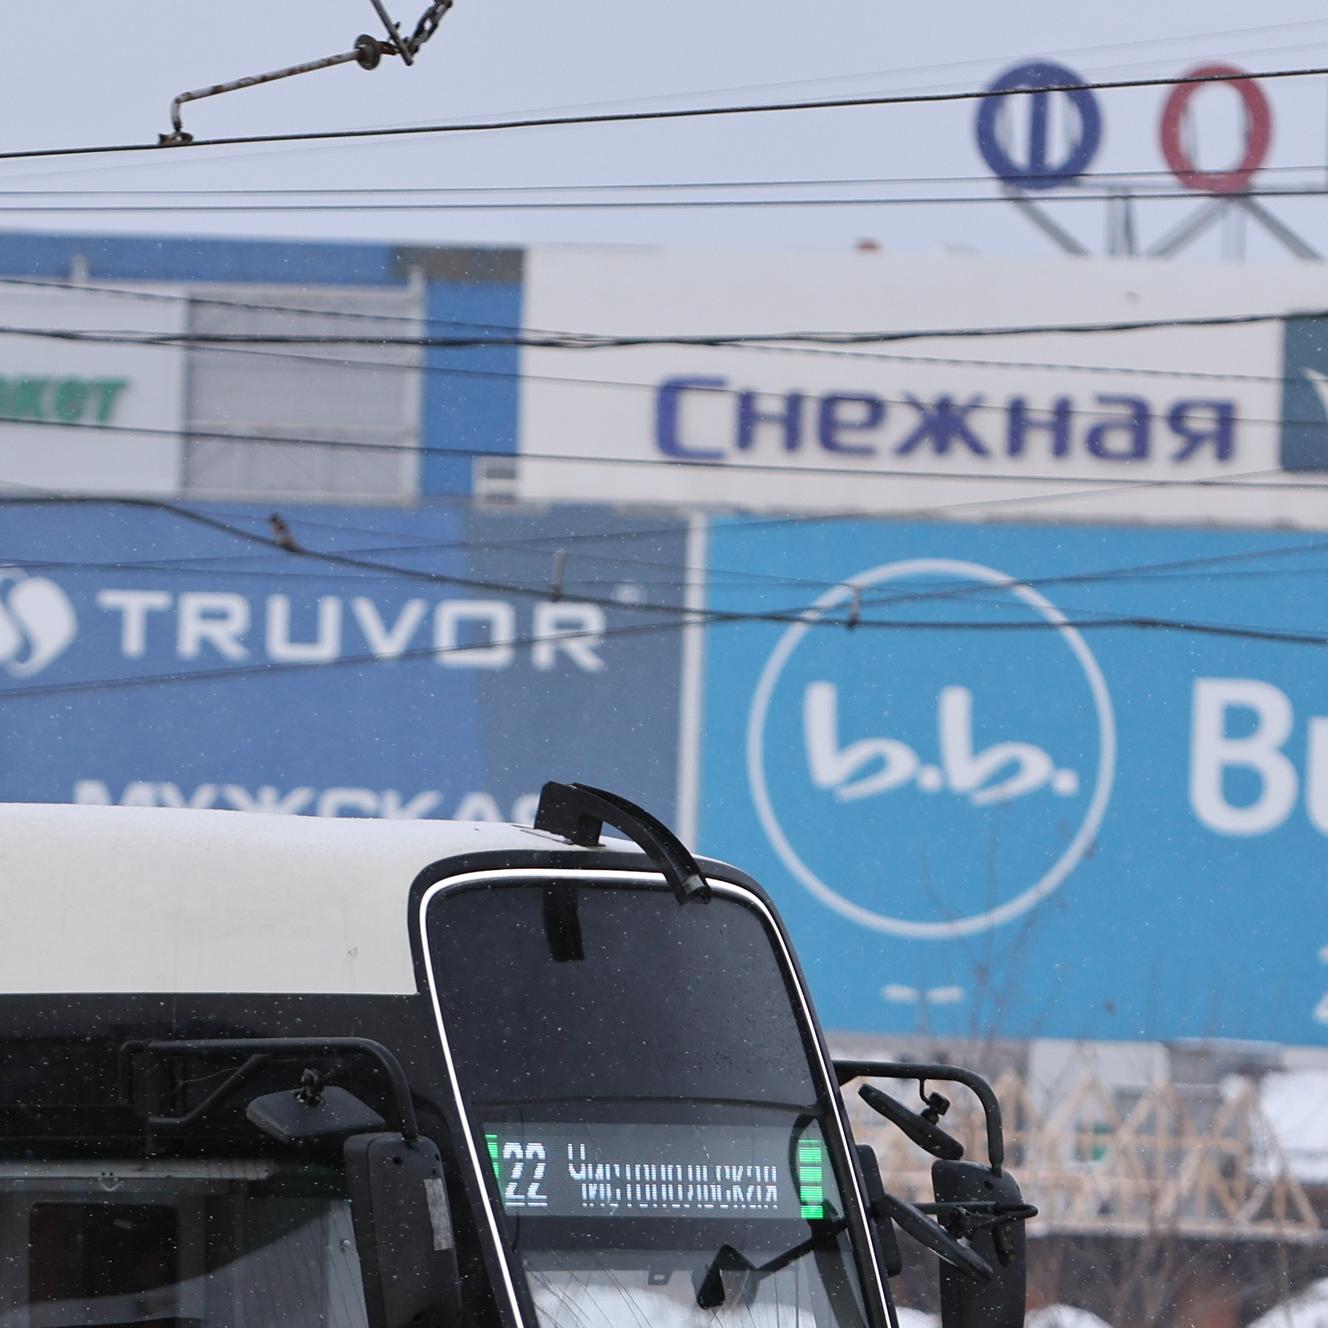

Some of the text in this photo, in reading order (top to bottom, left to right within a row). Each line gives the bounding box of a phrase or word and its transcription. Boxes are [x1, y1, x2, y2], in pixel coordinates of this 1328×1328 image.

[653, 375, 1236, 464] Снежная
[96, 590, 608, 672] TRUVOR
[503, 1142, 548, 1206] 22
